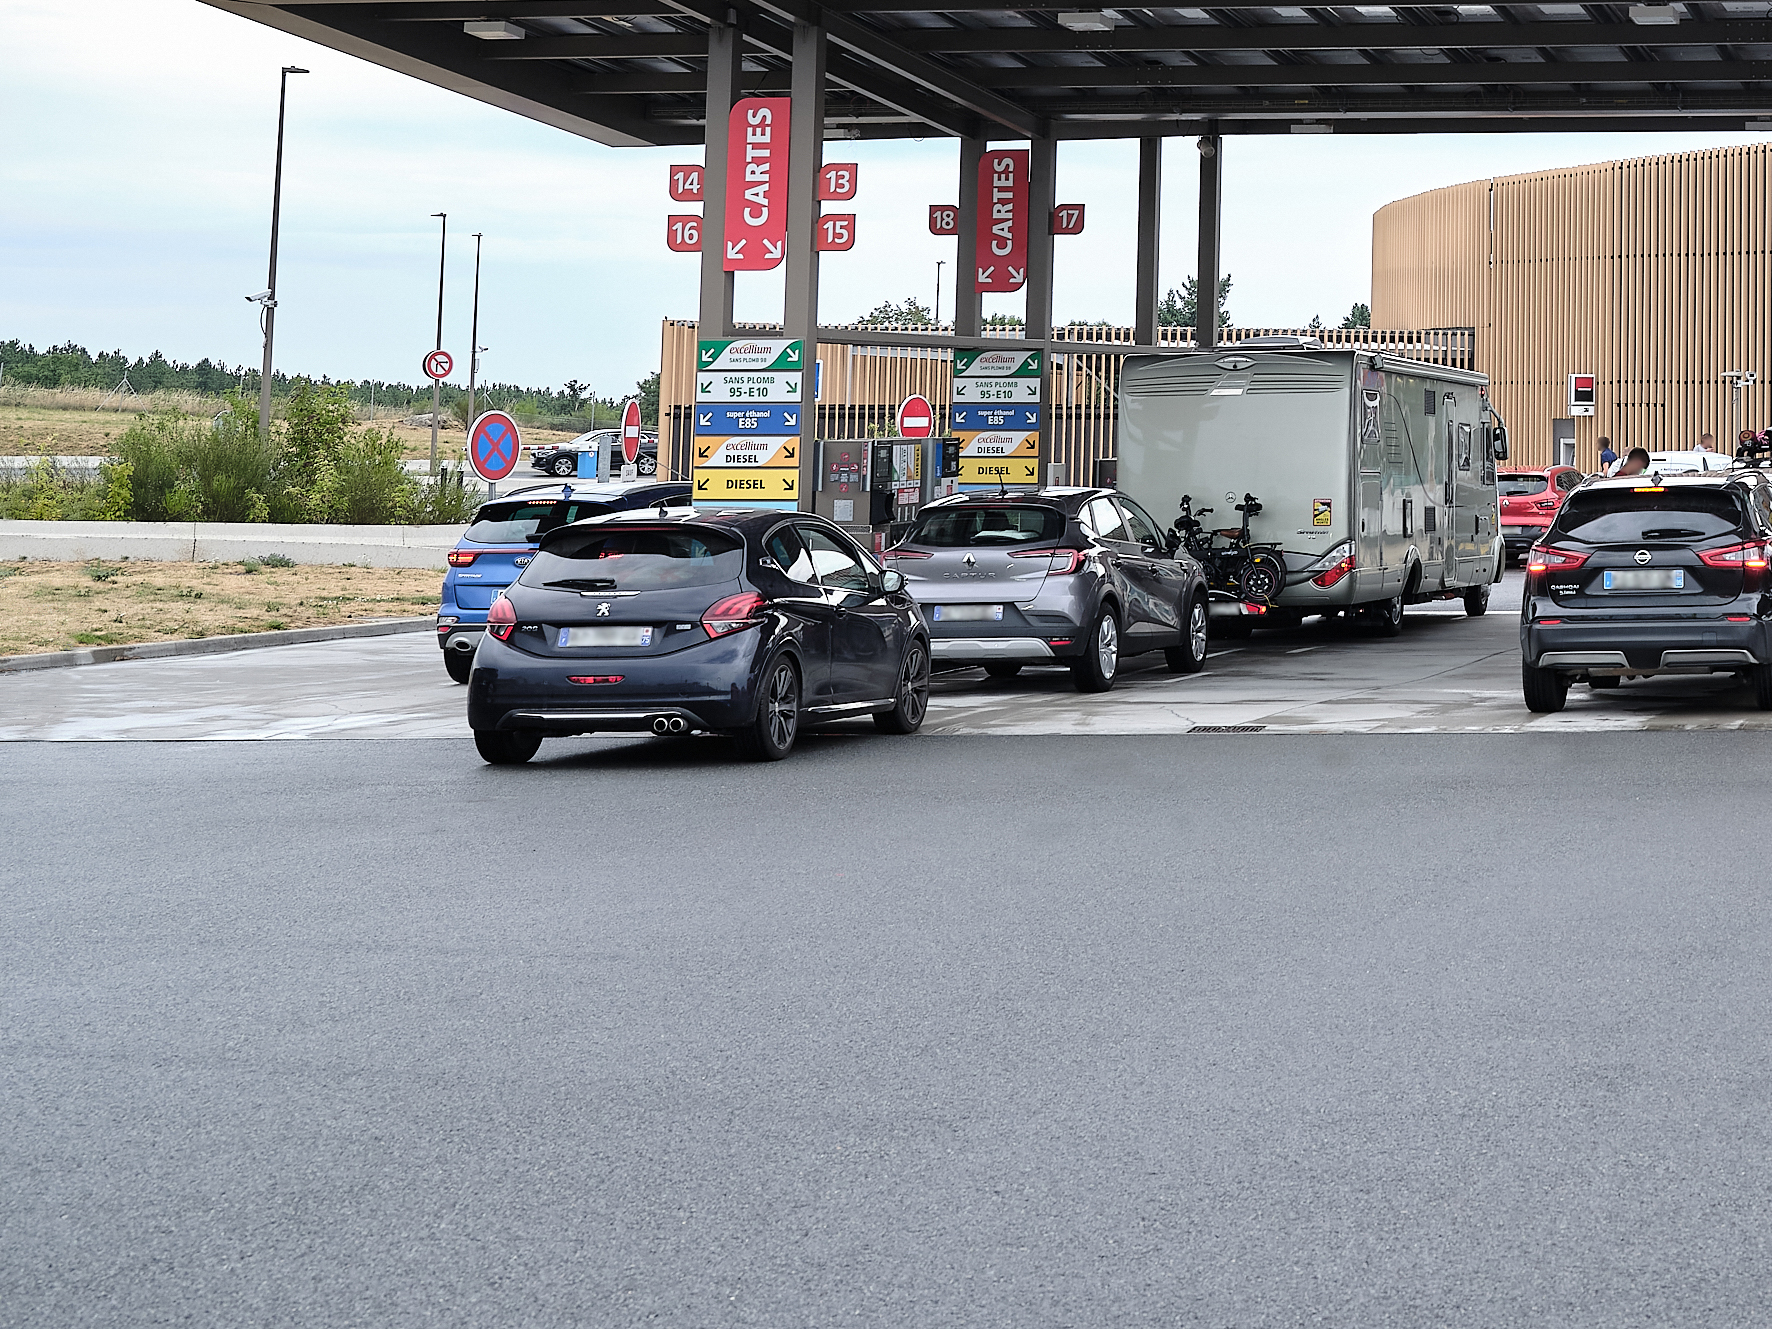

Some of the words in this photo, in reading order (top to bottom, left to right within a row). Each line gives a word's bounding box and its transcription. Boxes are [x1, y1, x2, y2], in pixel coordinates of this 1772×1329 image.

[743, 106, 773, 227] CARTES
[673, 172, 700, 195] 14
[825, 171, 850, 194] 13
[991, 157, 1016, 256] CARTES
[933, 210, 955, 230] 18
[1058, 210, 1080, 229] 17
[672, 221, 699, 245] 16
[823, 221, 849, 245] 15
[729, 343, 772, 355] excellium
[980, 355, 1015, 364] excellium
[723, 376, 745, 384] SANS
[747, 376, 775, 384] PLOMB
[729, 387, 768, 397] 95-E10
[980, 390, 1013, 399] 95-E10
[726, 411, 745, 419] super
[746, 410, 771, 418] éthanol
[738, 418, 758, 429] E85
[987, 416, 1004, 425] E85
[977, 435, 1013, 444] excellium
[725, 440, 768, 451] excellium
[977, 446, 1005, 454] DIESEL
[725, 454, 759, 463] DIESEL
[978, 466, 1011, 475] DIESEL
[726, 479, 766, 489] DIESEL
